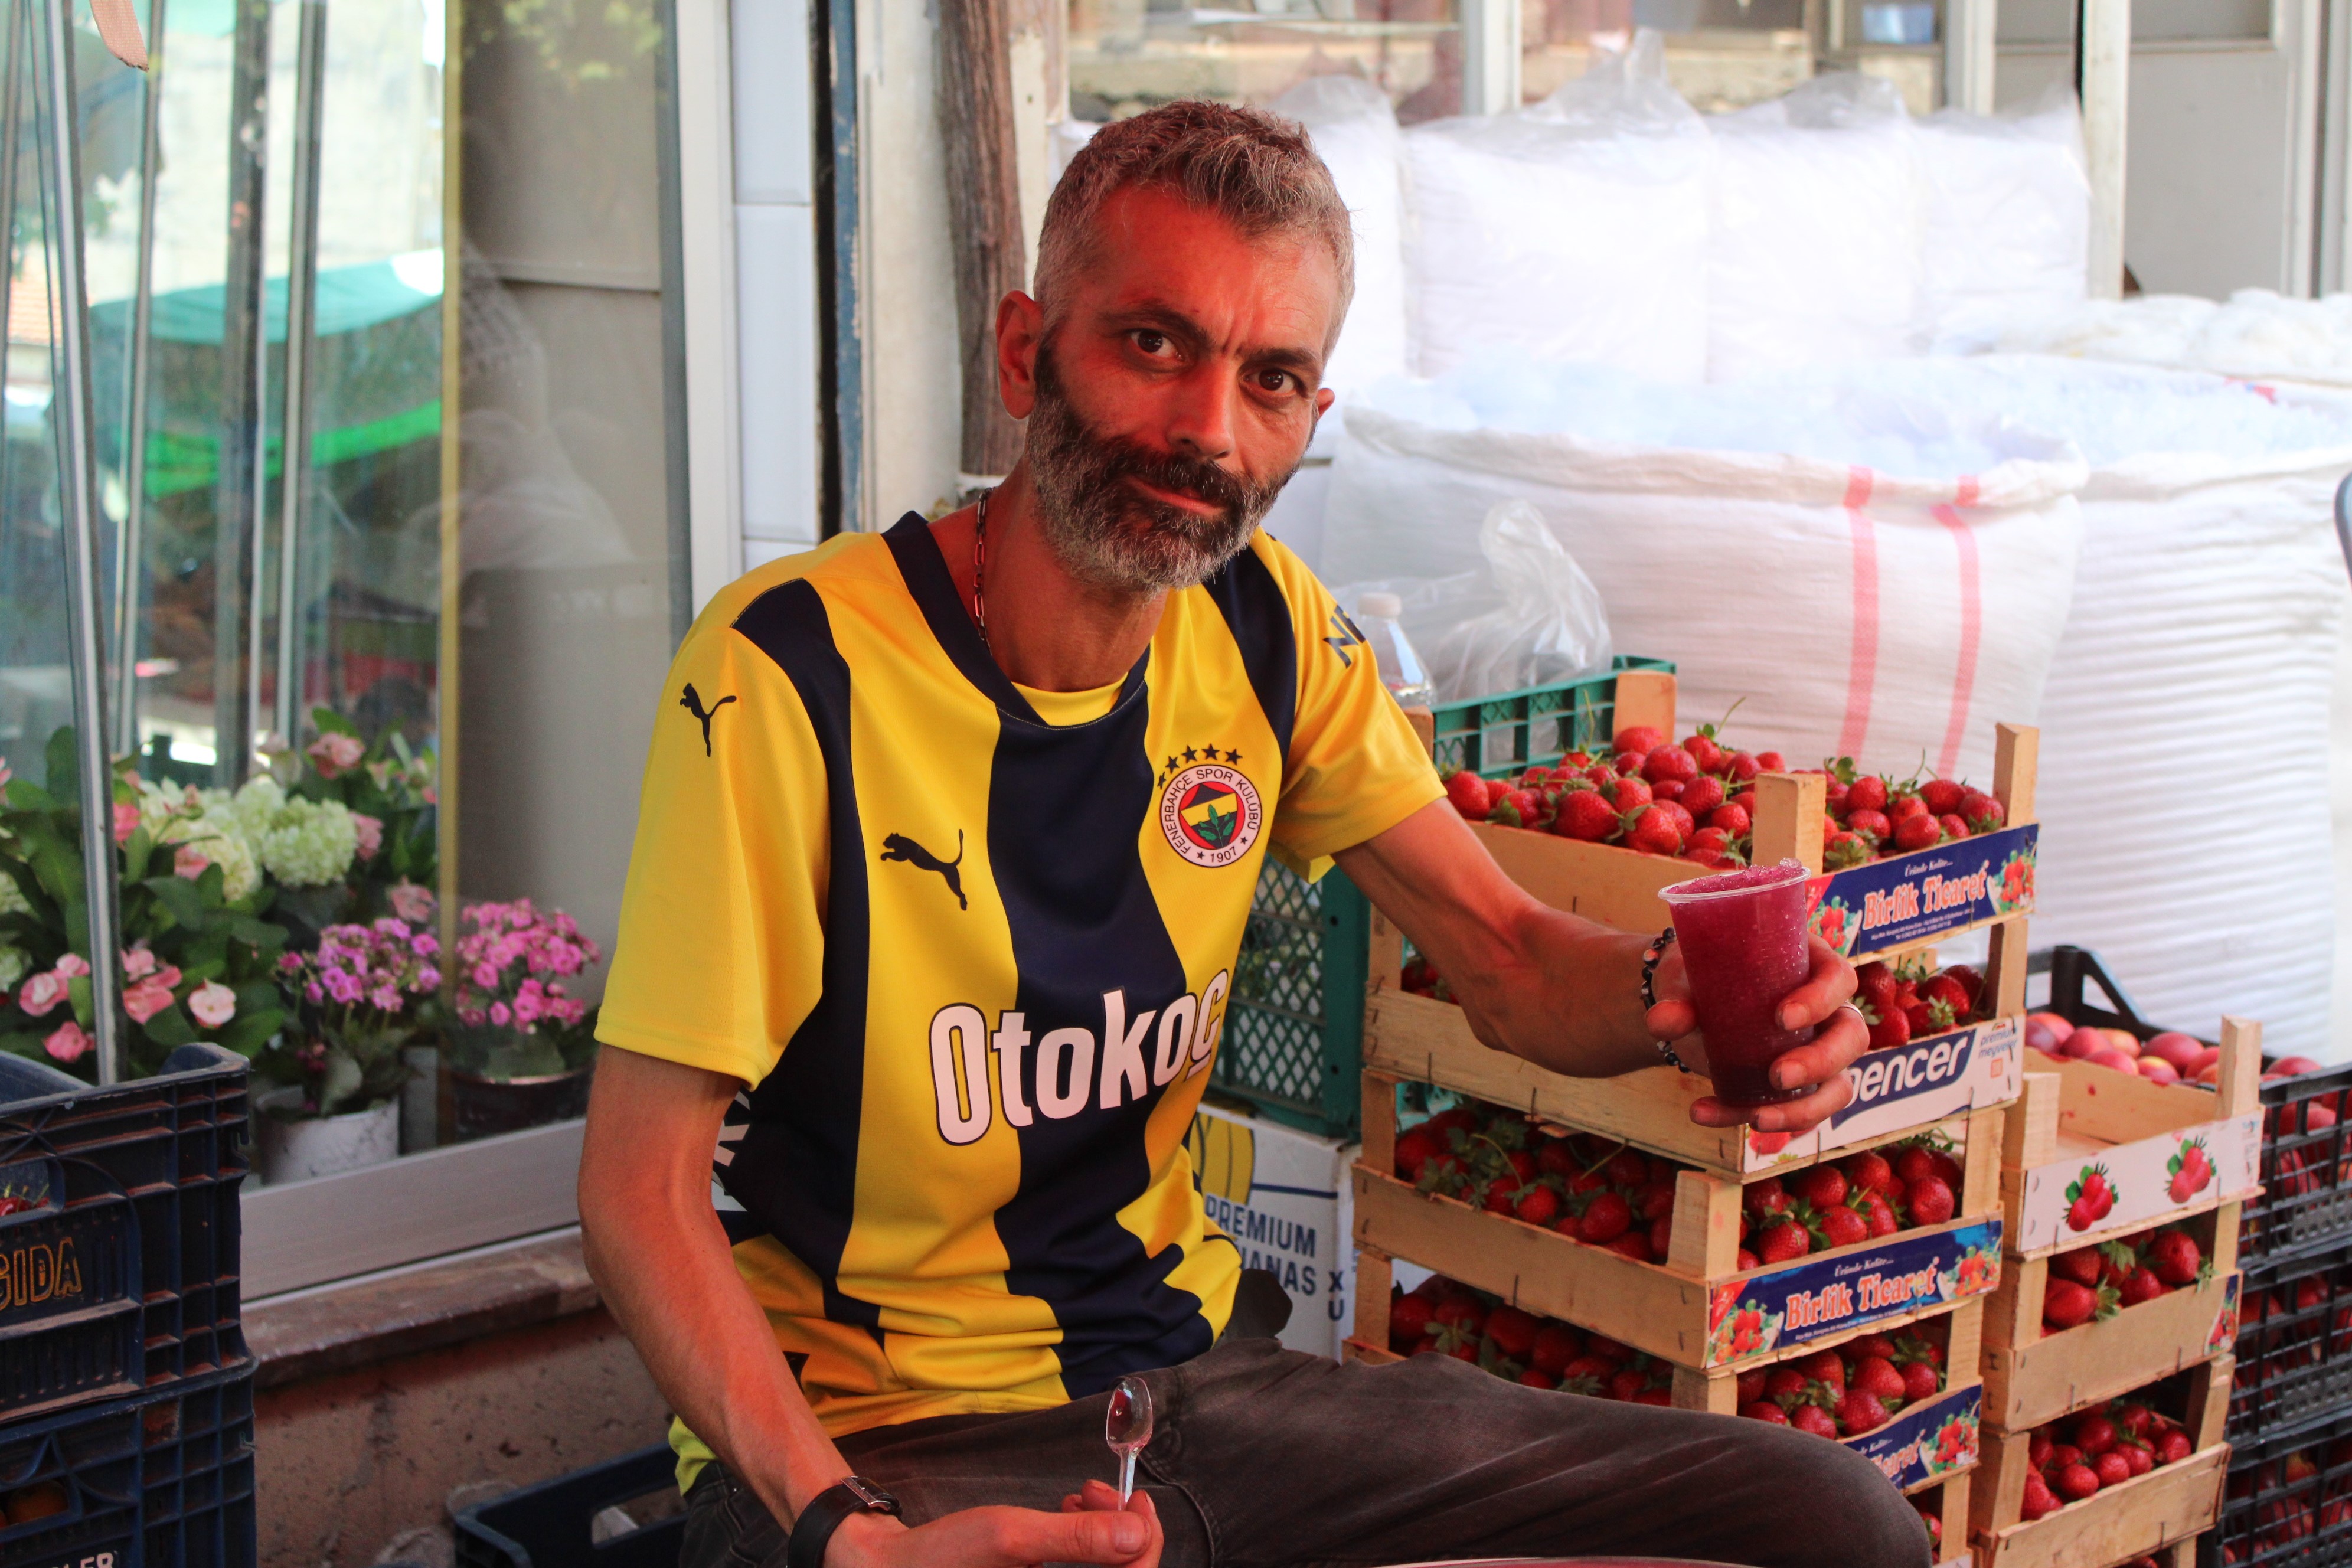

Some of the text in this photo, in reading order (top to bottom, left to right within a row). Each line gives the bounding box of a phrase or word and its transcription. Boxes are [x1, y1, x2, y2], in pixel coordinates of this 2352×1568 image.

[1164, 769, 1260, 854] FENERBAHÇE SPOR KULÜBÜ
[1210, 846, 1237, 863] 1907
[1862, 881, 1919, 930] Birlik
[1923, 867, 1988, 914] Ticaret
[1206, 1195, 1316, 1258] PREMIUM
[1328, 1271, 1344, 1292] X
[1328, 1299, 1344, 1321] U
[1785, 1284, 1853, 1331] Birlik
[1857, 1264, 1936, 1312] Ticaret
